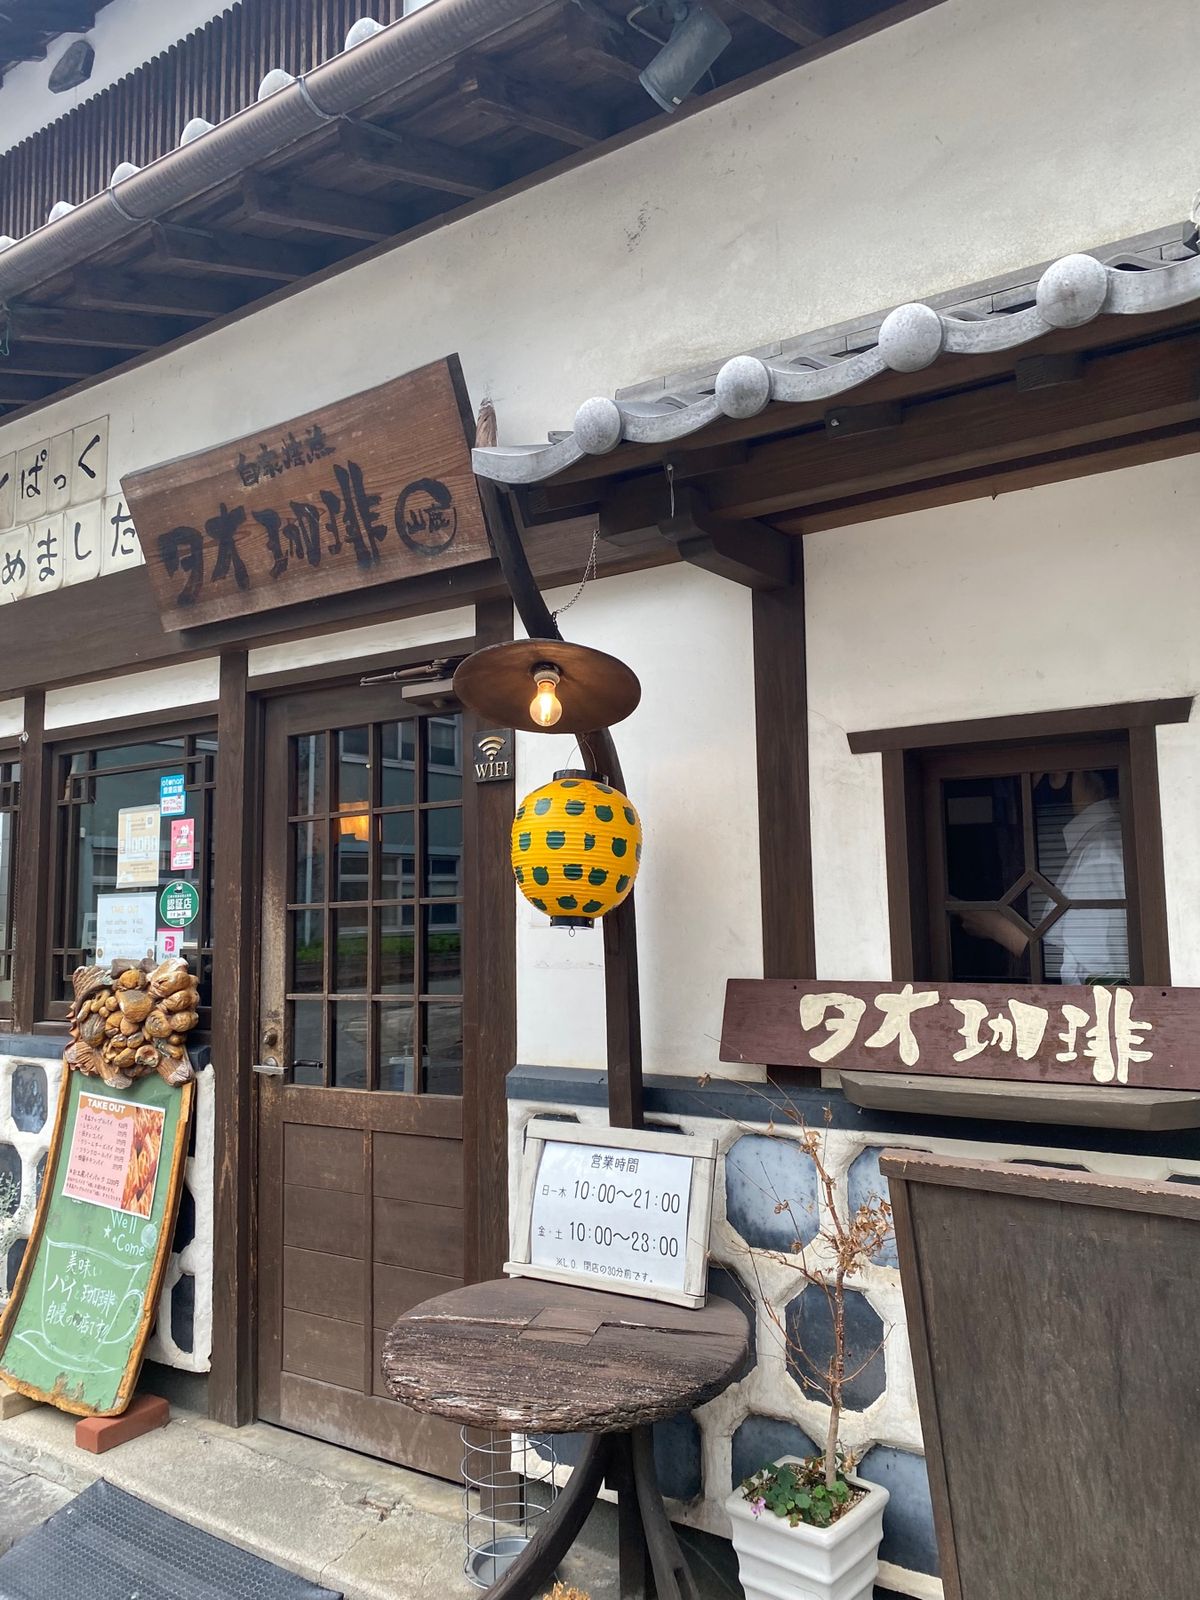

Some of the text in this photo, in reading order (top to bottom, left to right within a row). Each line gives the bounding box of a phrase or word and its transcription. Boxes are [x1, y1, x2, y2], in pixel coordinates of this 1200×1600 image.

[800, 983, 1153, 1084] タオ珈琲
[87, 1098, 126, 1113] TAKE OUT
[590, 1153, 640, 1174] 営業時間
[116, 1233, 145, 1256] Come
